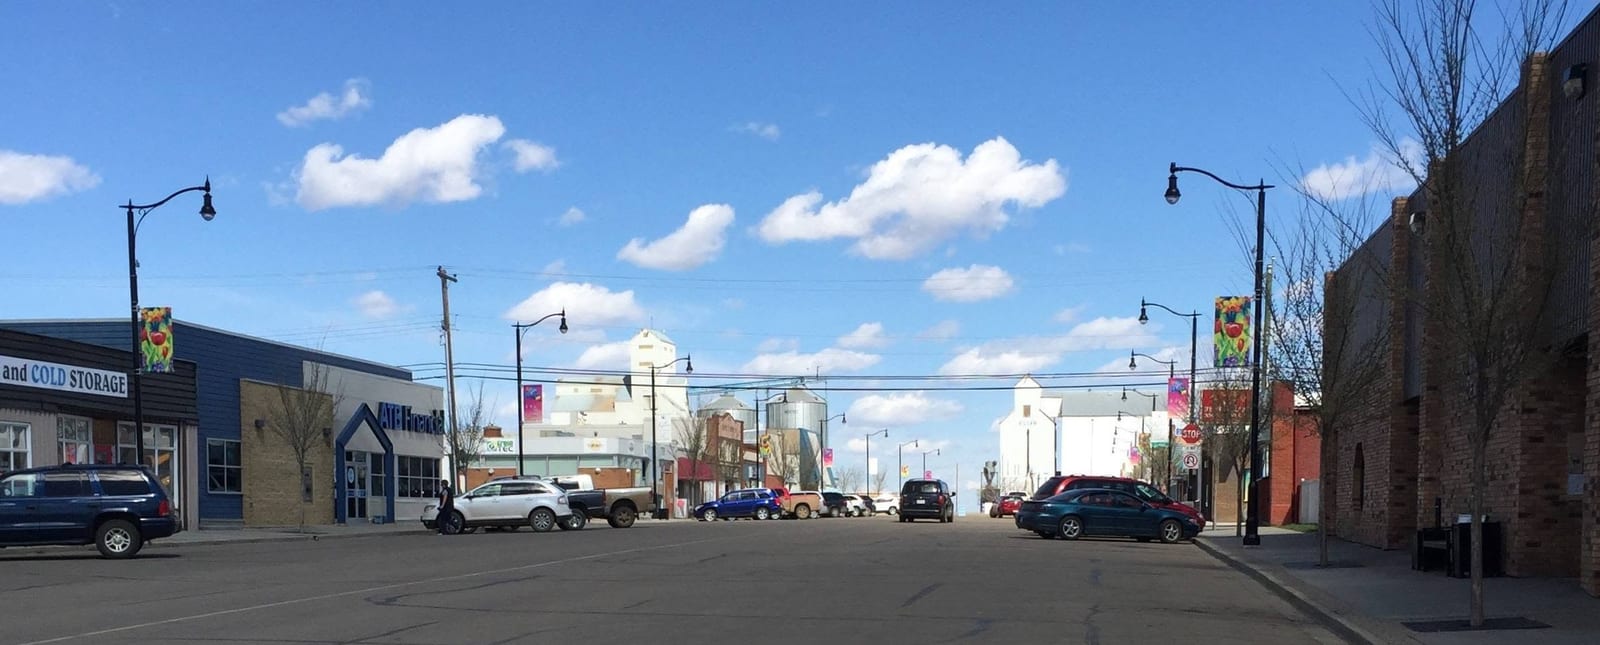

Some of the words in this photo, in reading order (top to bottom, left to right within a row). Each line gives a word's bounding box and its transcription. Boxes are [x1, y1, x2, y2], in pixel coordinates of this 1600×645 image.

[2, 363, 27, 382] and
[31, 364, 66, 386] COLD
[69, 369, 126, 394] STORAGE
[378, 402, 402, 430] ATB
[402, 405, 445, 435] Financial
[1182, 429, 1201, 438] STOP
